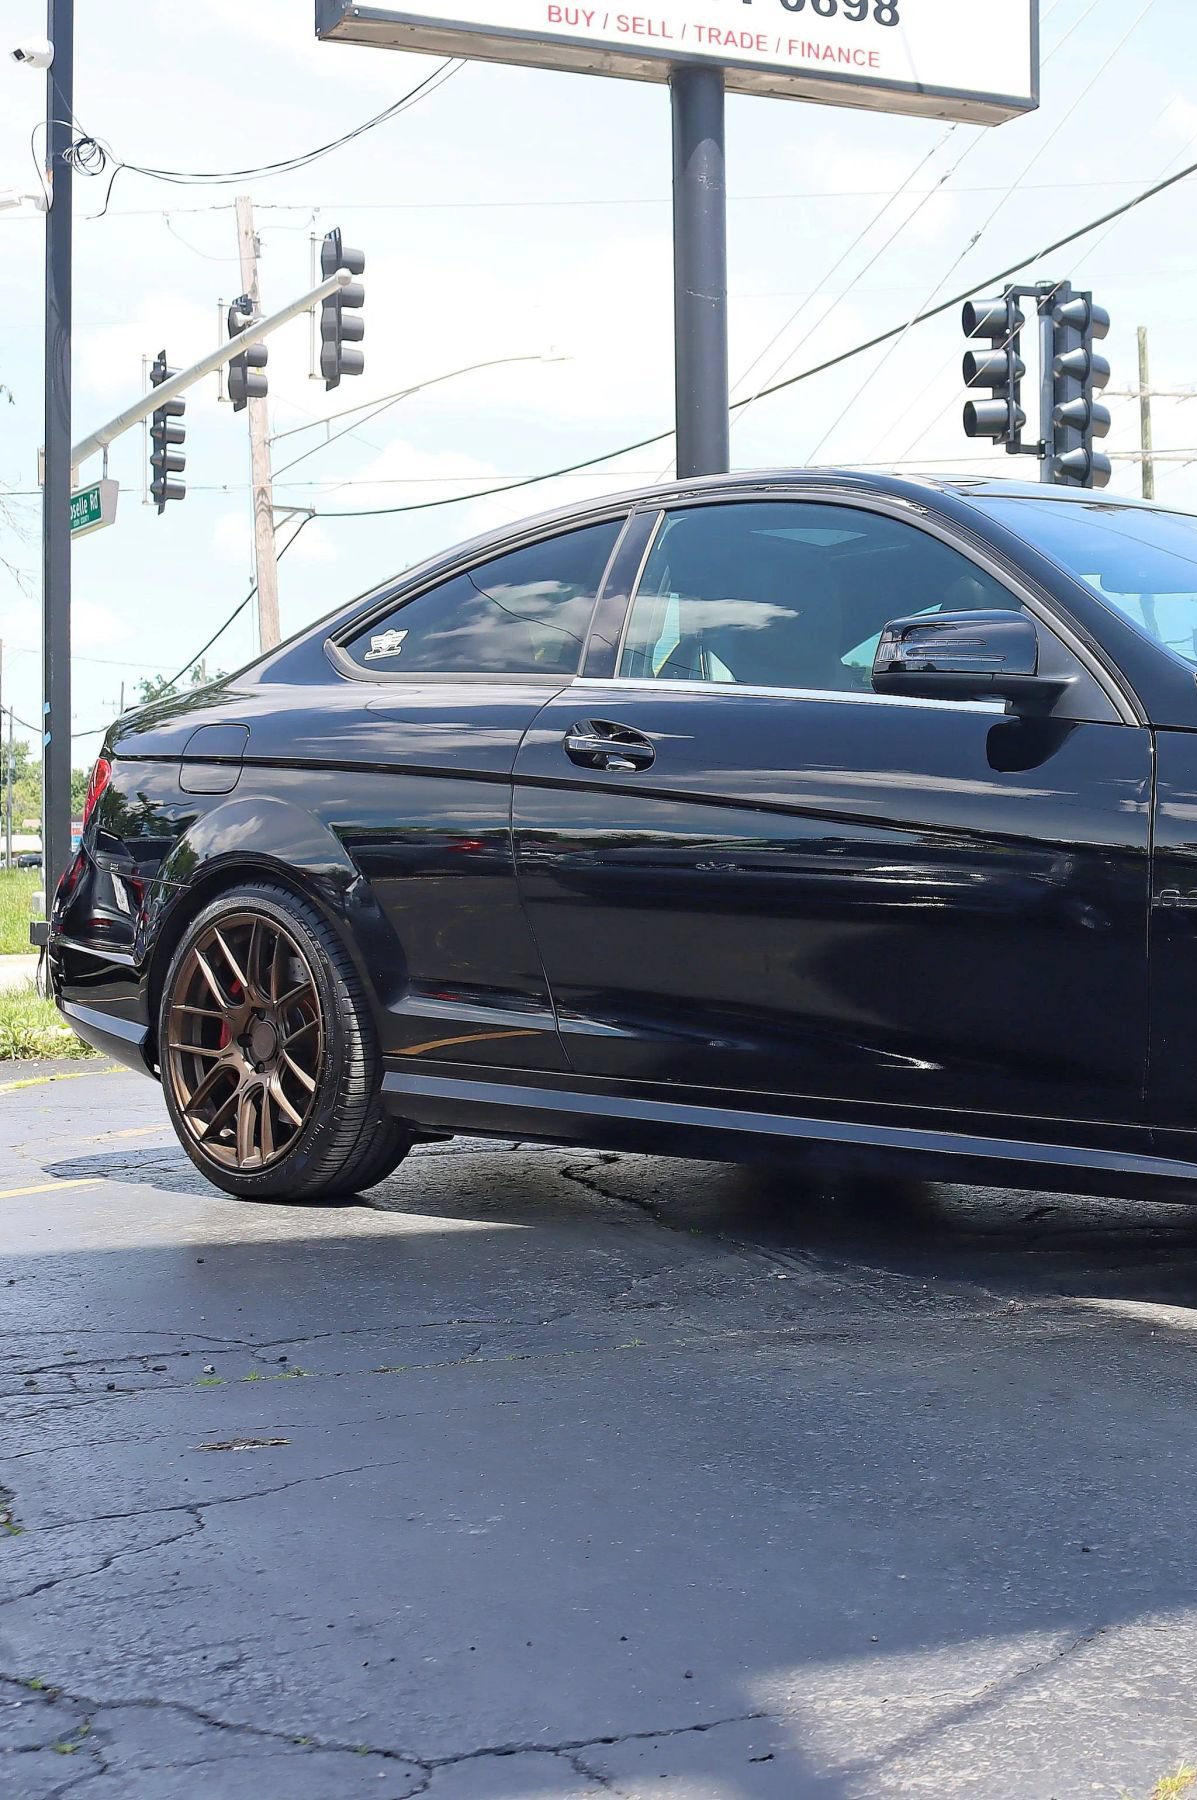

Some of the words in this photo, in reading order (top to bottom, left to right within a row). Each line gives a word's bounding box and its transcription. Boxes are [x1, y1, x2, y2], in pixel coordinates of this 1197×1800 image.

[547, 5, 596, 27] BUY
[603, 13, 609, 30] /
[616, 14, 673, 39] SELL
[681, 23, 687, 40] /
[694, 24, 768, 52] TRADE
[775, 37, 781, 54] /
[788, 38, 881, 68] FINANCE
[89, 490, 98, 512] Rd
